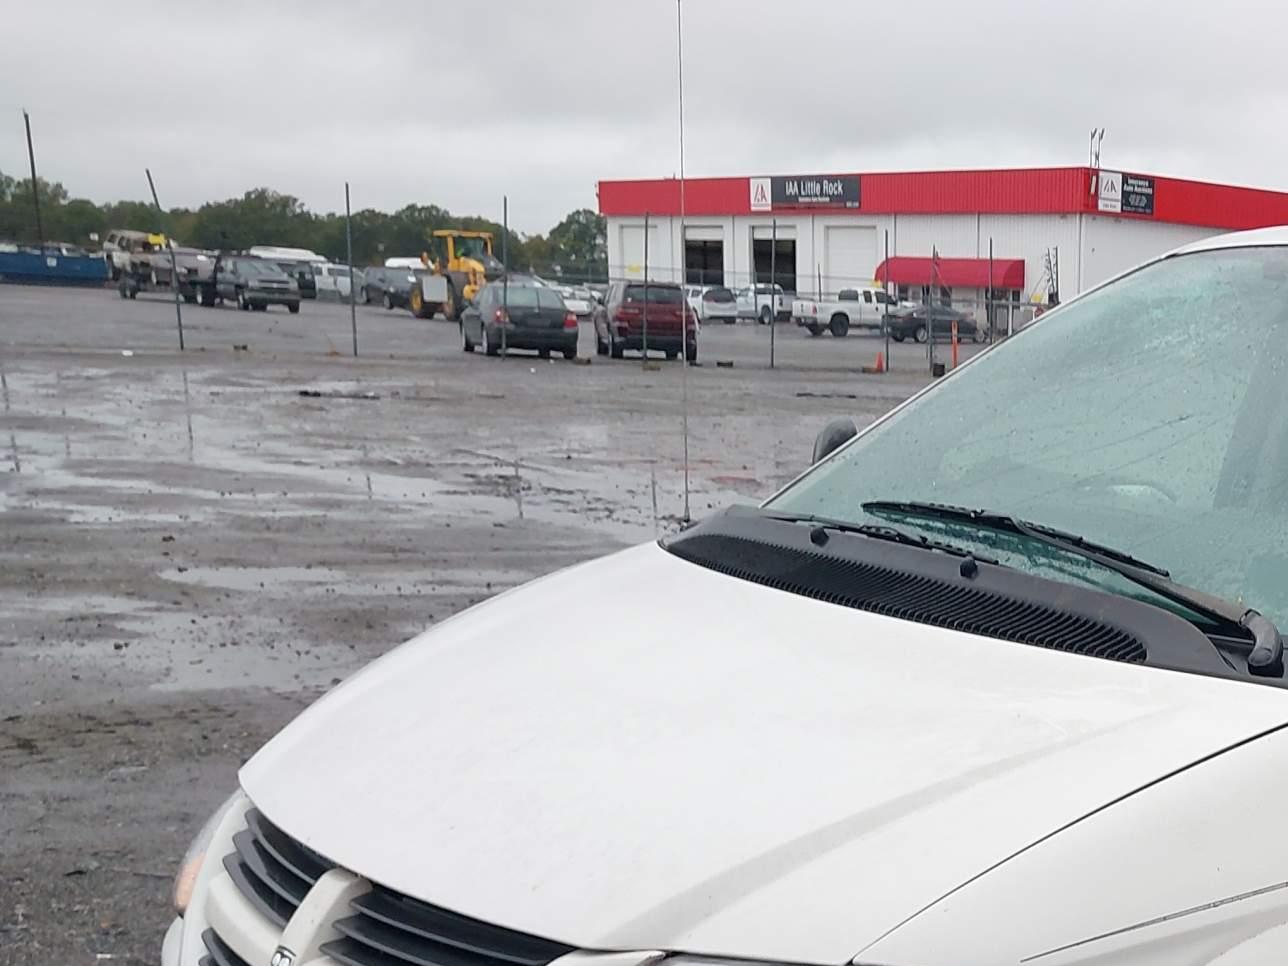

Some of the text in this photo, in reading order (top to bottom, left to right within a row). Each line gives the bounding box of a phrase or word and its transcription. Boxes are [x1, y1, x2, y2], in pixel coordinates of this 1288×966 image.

[785, 180, 844, 196] IAA Little Rock
